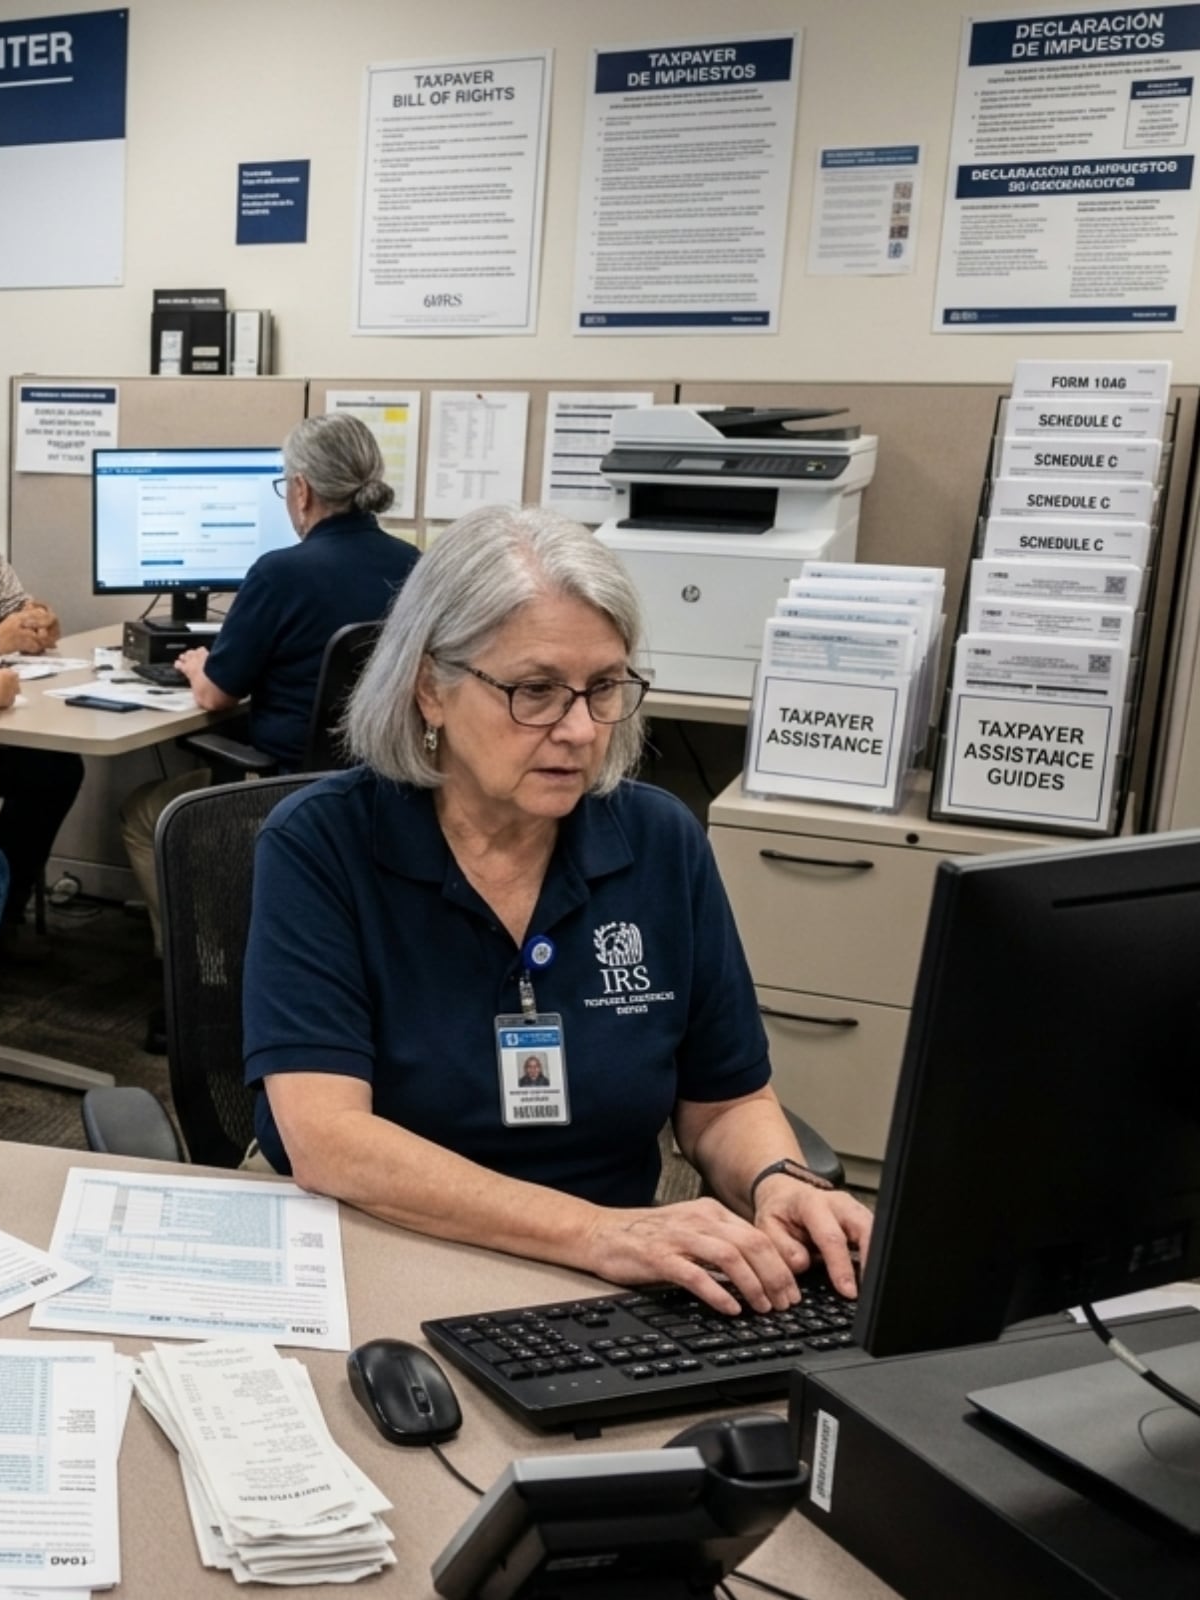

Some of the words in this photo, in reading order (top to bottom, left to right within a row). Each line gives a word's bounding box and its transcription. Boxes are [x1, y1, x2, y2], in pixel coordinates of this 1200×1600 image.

[1016, 12, 1164, 39] DECLARACIÓN
[1011, 41, 1039, 58] DE
[1044, 32, 1165, 56] IMPUESTOS
[648, 48, 736, 68] TAXPAYER
[627, 71, 651, 87] DE
[392, 93, 426, 108] BILL
[430, 90, 451, 105] OF
[455, 86, 516, 103] RIGHTS
[1051, 376, 1089, 389] FORM
[1112, 415, 1122, 428] C
[1108, 455, 1118, 468] C
[1100, 496, 1111, 510] C
[1094, 538, 1104, 551] C
[779, 707, 874, 732] TAXPAYER
[766, 728, 883, 755] ASSISTANCE
[978, 720, 1084, 745] TAXPAYER
[987, 768, 1065, 790] GUIDES
[600, 965, 651, 994] IRS
